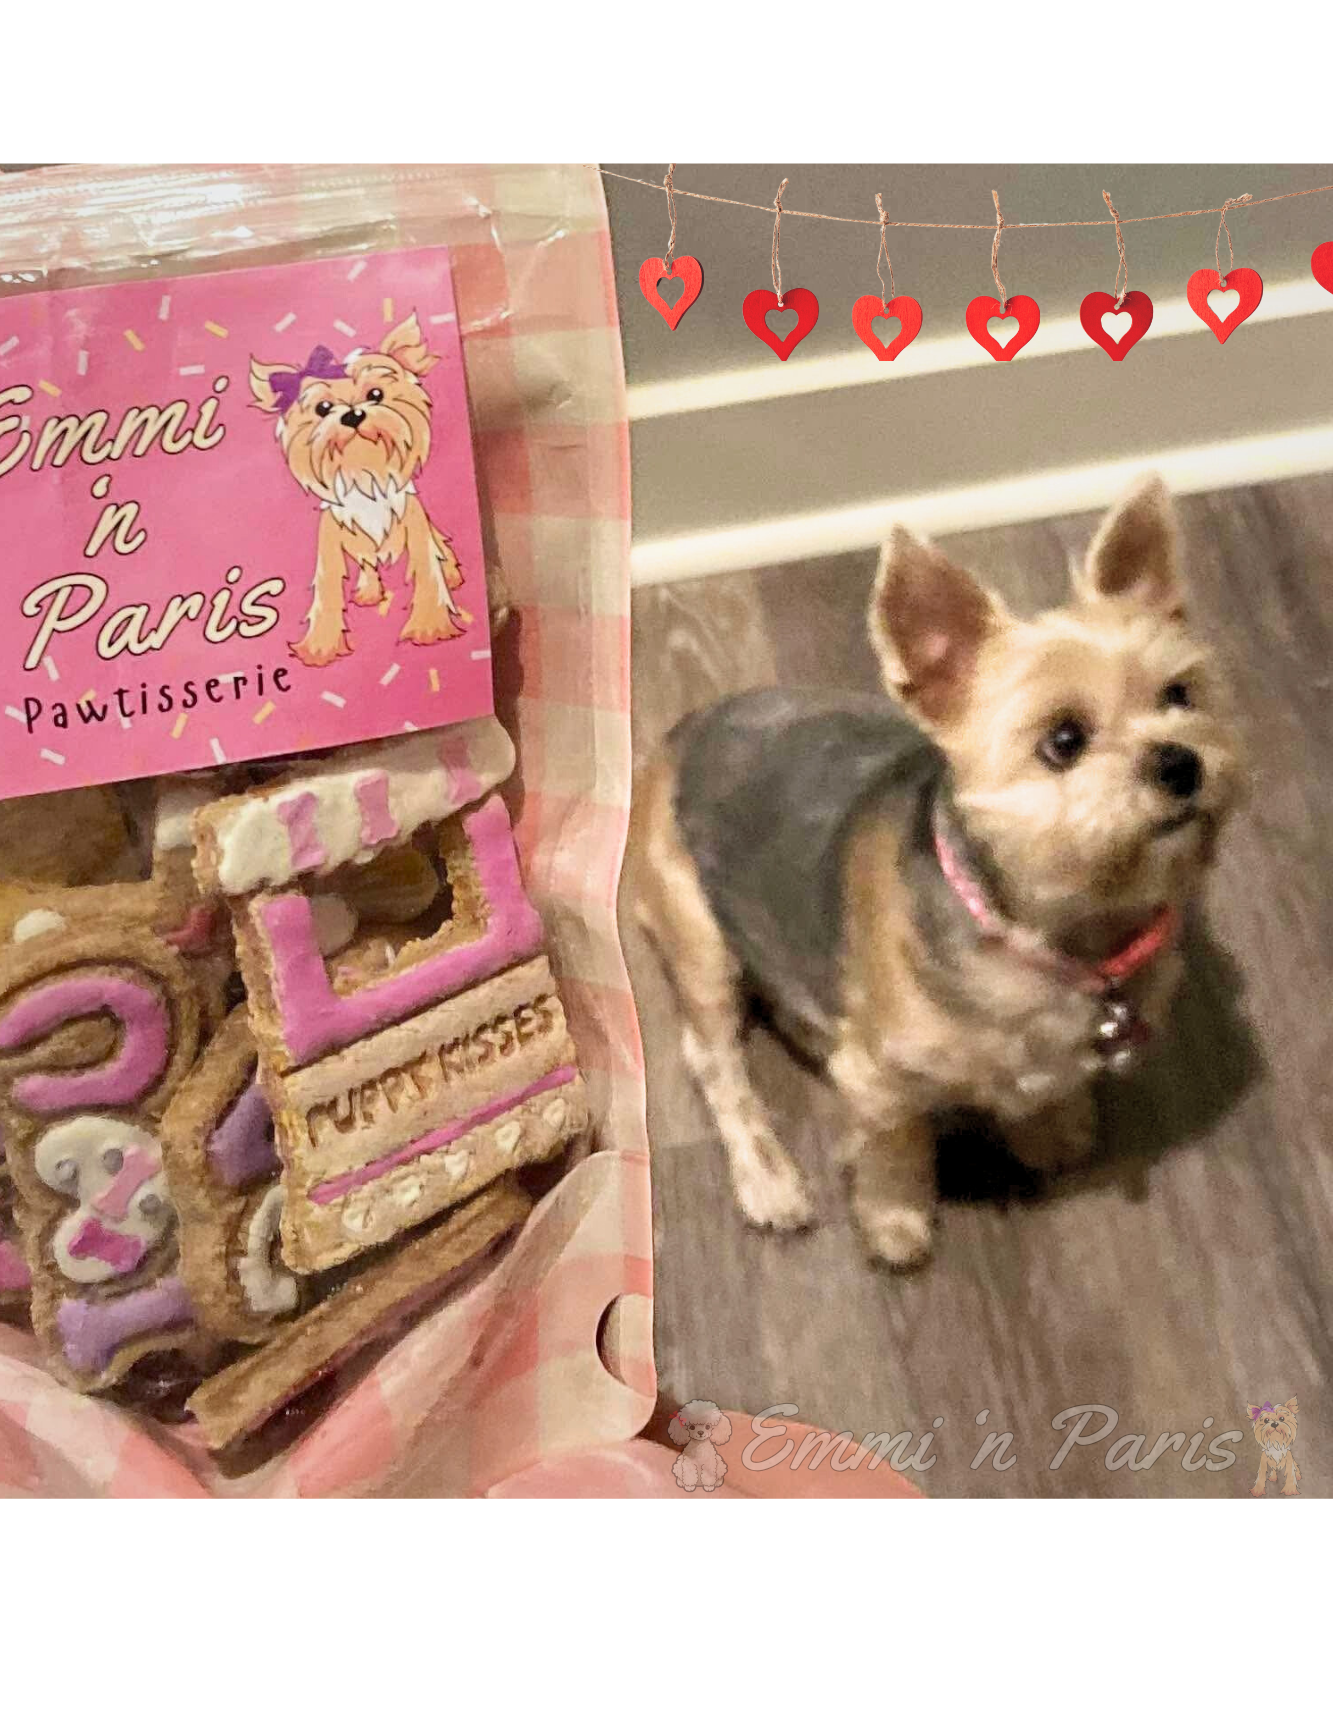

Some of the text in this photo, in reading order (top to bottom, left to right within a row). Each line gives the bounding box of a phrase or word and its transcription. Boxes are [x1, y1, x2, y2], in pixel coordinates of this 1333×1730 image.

[0, 375, 229, 478] Emmi
[21, 565, 286, 671] Paris
[23, 664, 292, 734] Pawtisserie
[438, 992, 553, 1083] KISSES
